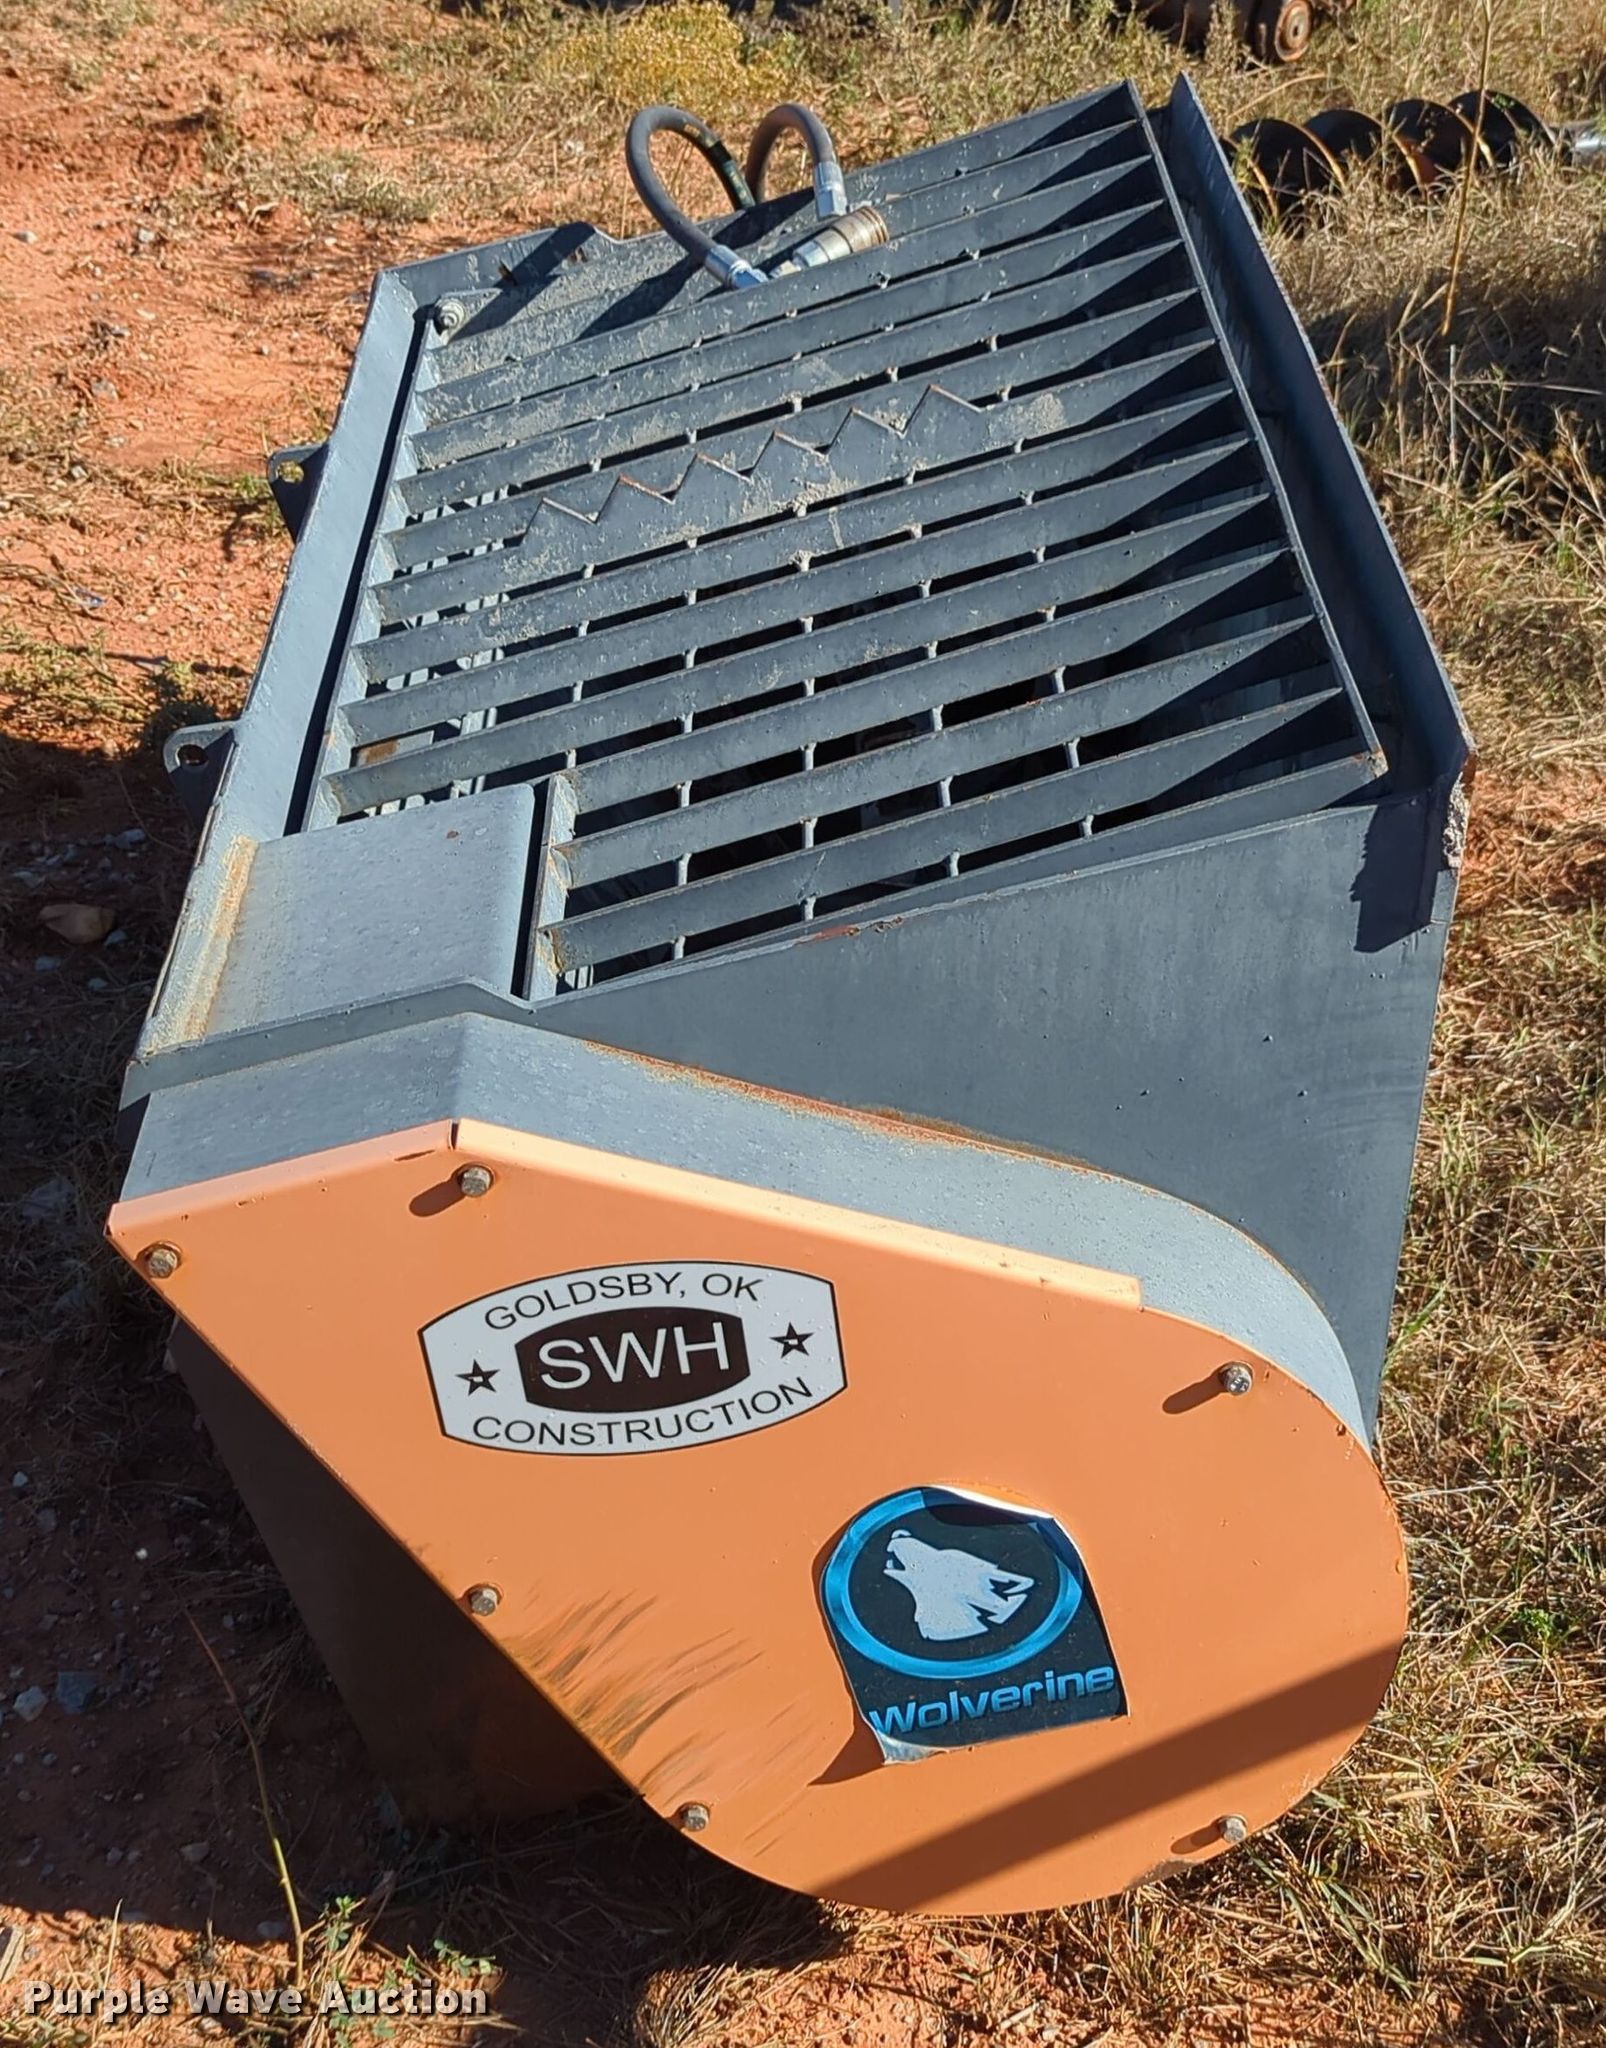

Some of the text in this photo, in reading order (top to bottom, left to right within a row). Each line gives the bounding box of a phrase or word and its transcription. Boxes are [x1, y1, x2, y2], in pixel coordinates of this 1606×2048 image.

[484, 1272, 764, 1331] GOLDSBY, OK
[538, 1321, 731, 1390] SWH
[472, 1376, 813, 1446] CONSTRUCTION
[869, 1665, 1115, 1735] Wolverine
